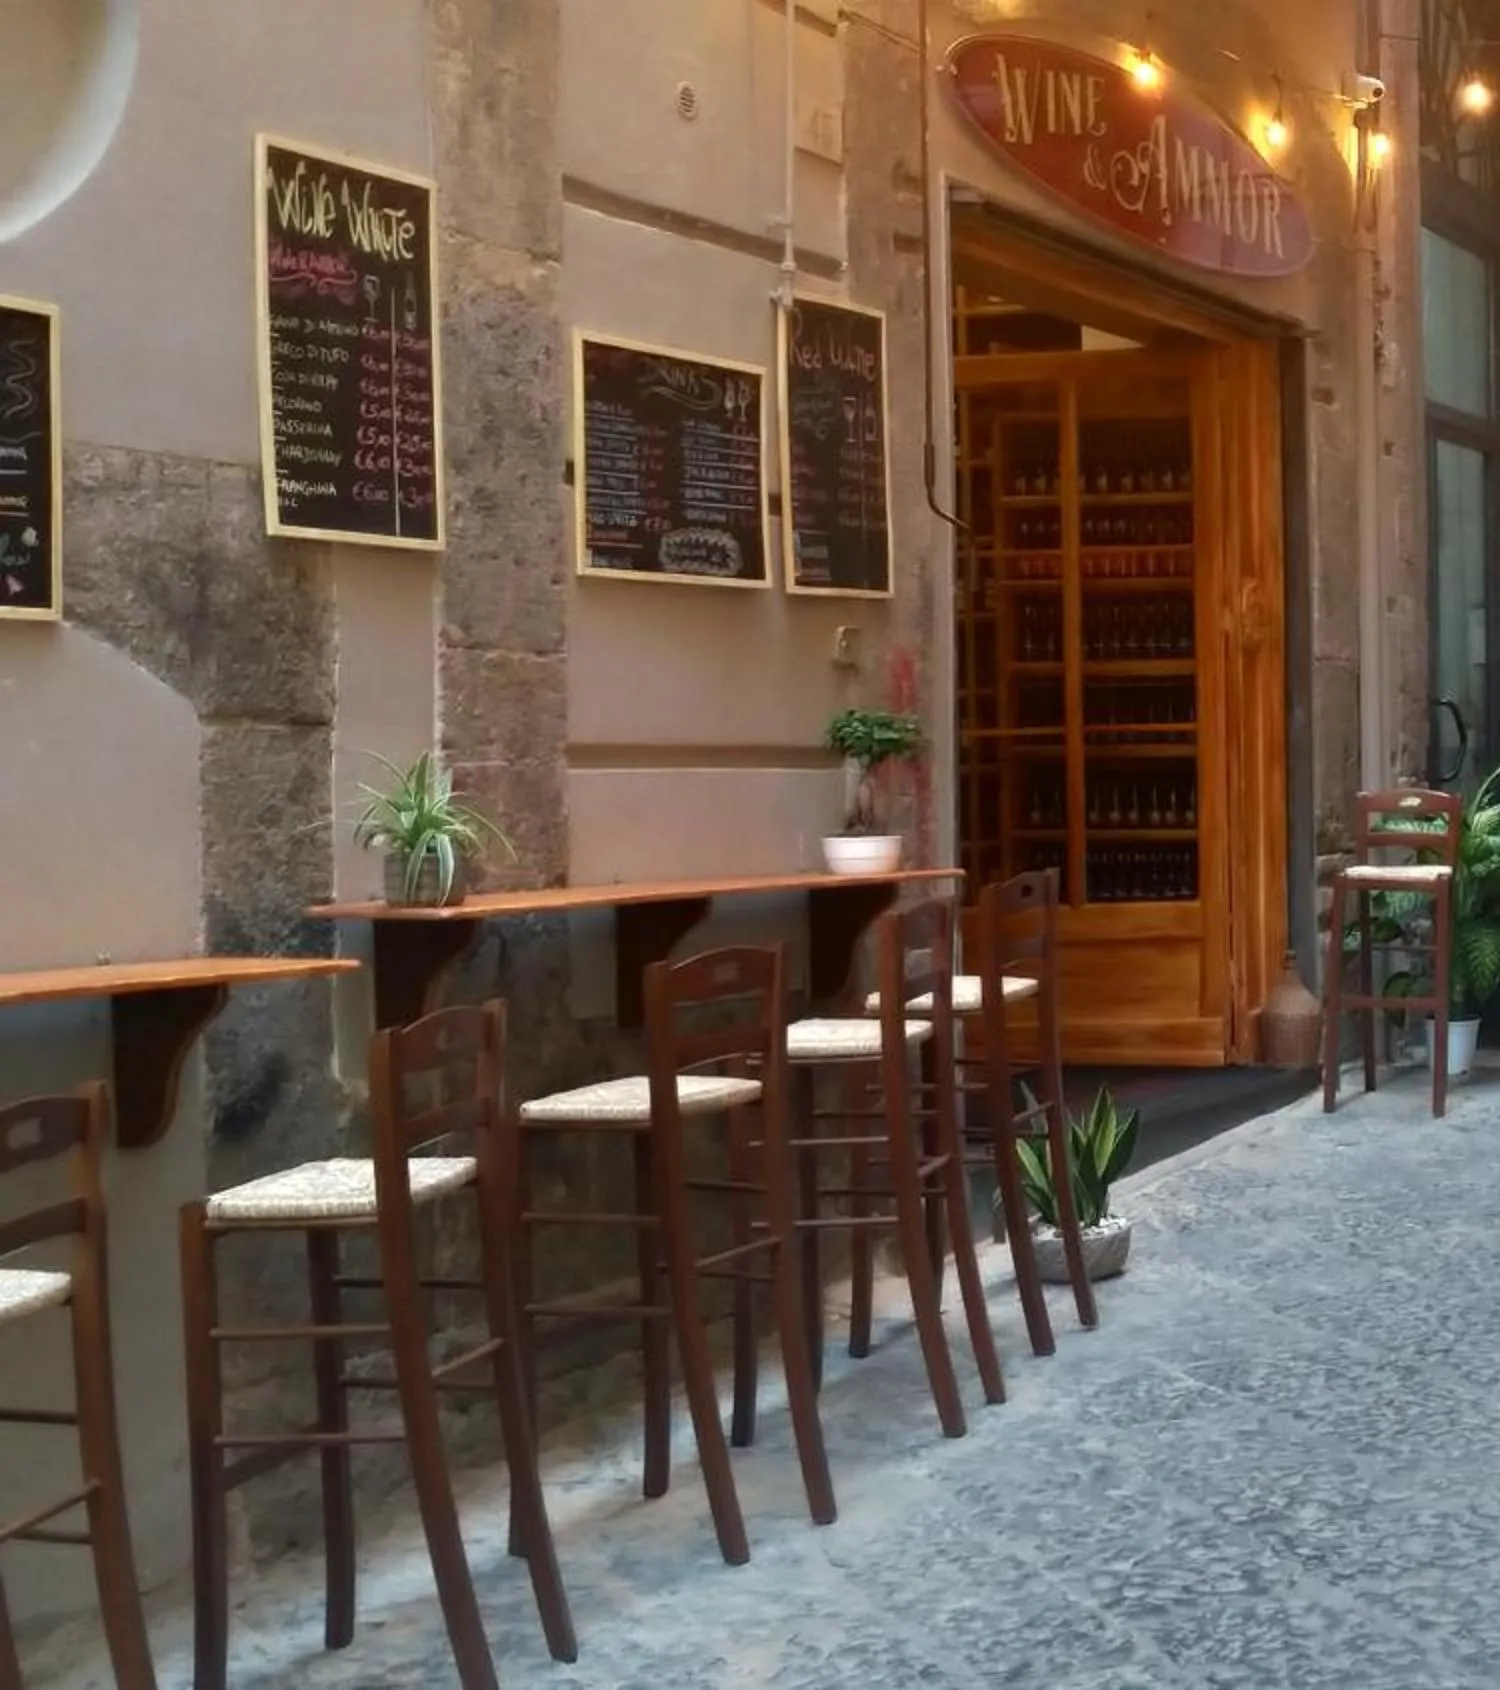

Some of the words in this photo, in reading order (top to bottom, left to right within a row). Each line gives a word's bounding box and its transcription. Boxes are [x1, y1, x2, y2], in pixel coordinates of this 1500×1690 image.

[993, 54, 1108, 145] WINE
[1083, 143, 1107, 190] &
[1110, 114, 1286, 259] AMMOR
